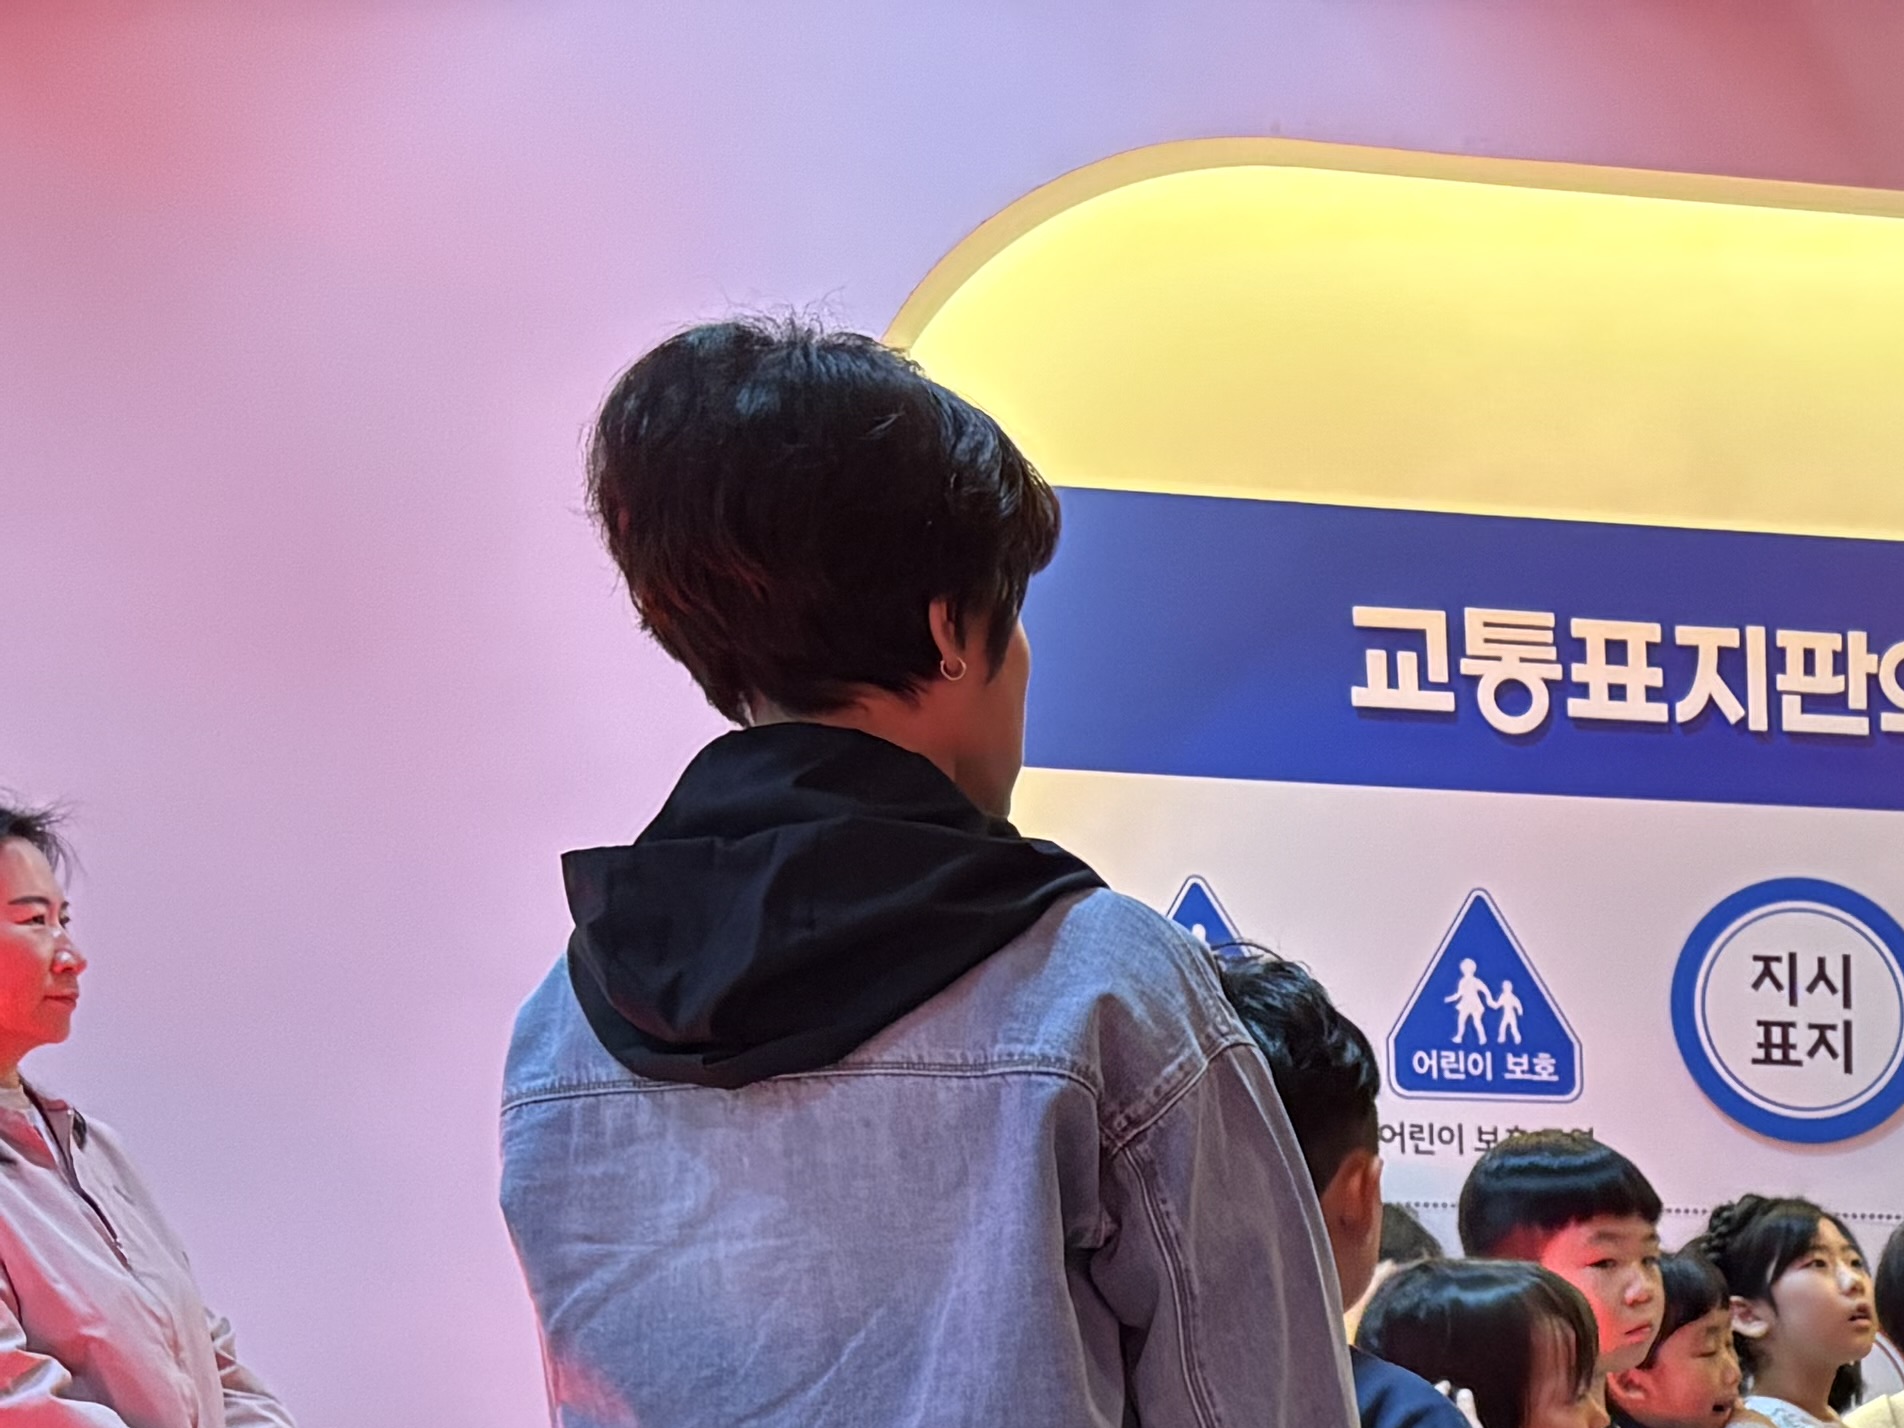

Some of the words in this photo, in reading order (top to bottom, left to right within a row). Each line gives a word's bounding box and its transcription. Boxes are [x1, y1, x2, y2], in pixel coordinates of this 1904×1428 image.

[1749, 950, 1855, 1008] 지시
[1412, 1050, 1493, 1081] 어린이
[1504, 1052, 1559, 1082] 보호
[1750, 1015, 1857, 1077] 표지
[1378, 1121, 1464, 1156] 어린이
